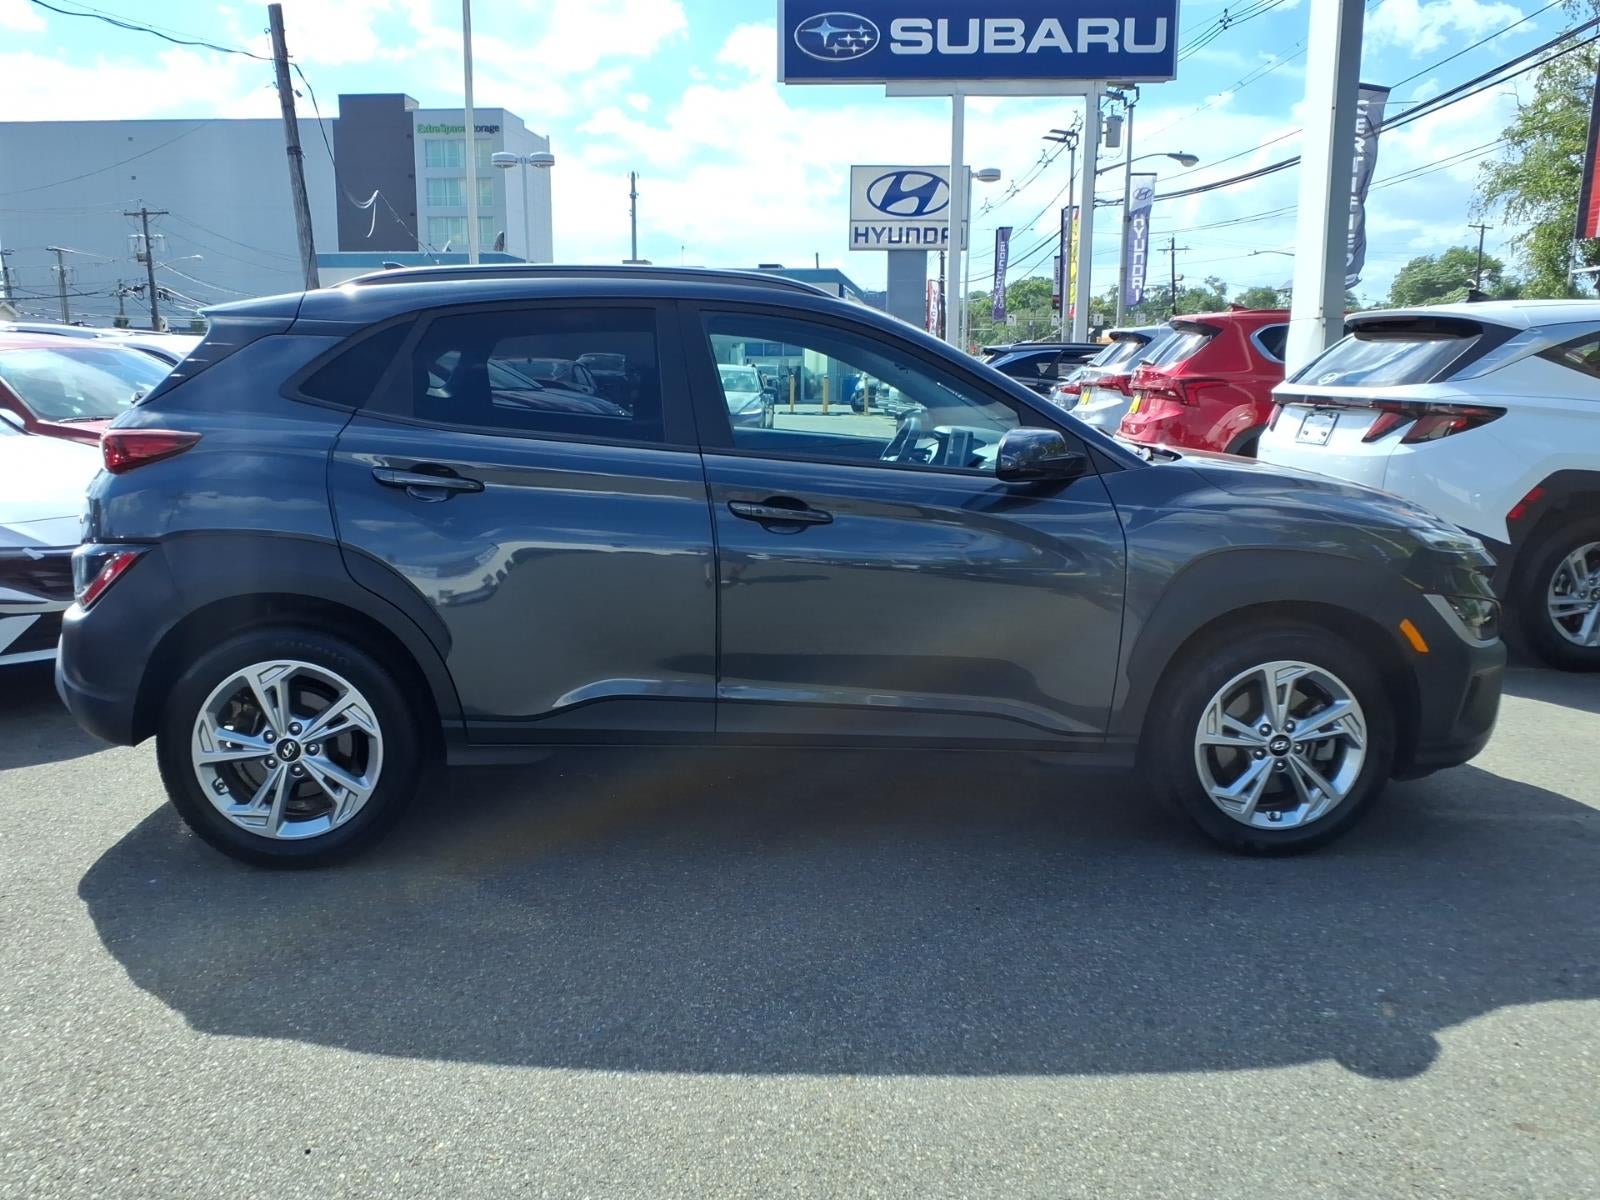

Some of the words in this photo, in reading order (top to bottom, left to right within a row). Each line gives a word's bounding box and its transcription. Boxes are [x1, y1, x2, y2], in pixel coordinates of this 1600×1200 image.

[890, 17, 1166, 55] SUBARU
[473, 123, 500, 134] torage
[994, 241, 1006, 289] HYUNDAI
[1131, 212, 1146, 302] HYUNDAI
